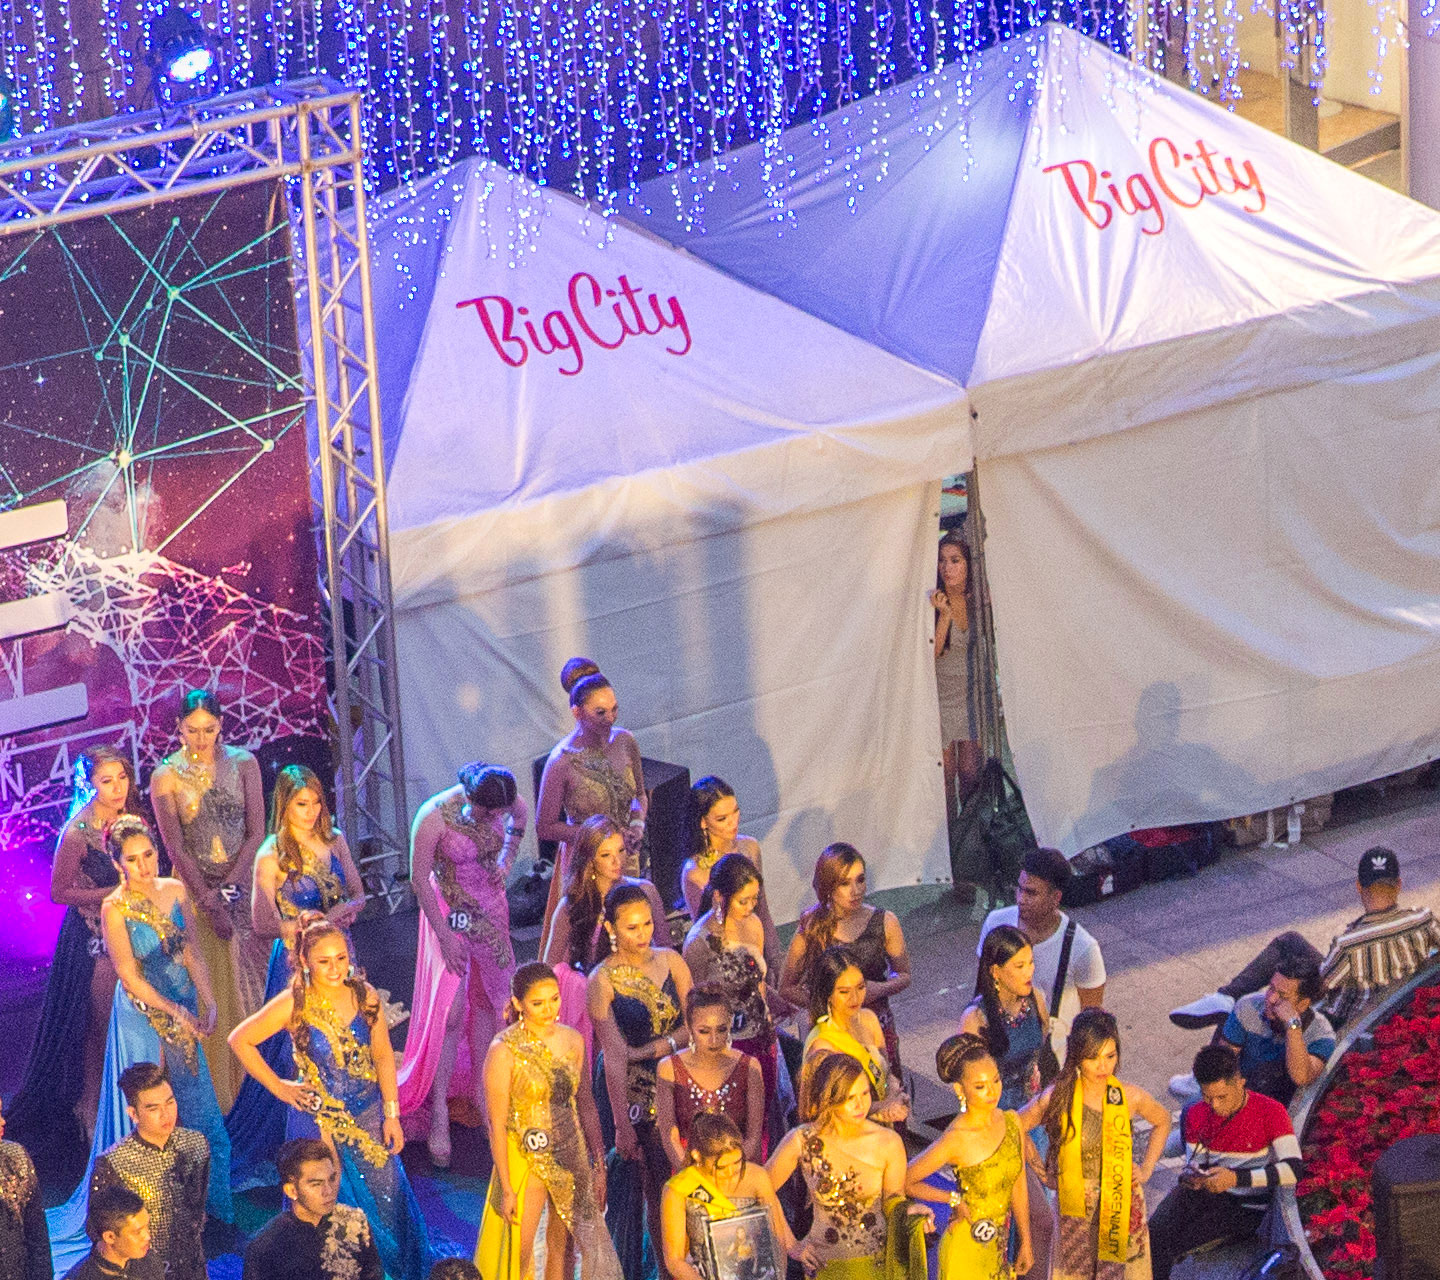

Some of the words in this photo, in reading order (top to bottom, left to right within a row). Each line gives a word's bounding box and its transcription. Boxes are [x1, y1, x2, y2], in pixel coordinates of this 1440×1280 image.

[1042, 137, 1266, 235] BigCity
[456, 271, 692, 376] BigCity
[50, 746, 76, 788] 4
[449, 912, 468, 929] 19
[527, 1133, 548, 1150] 09
[974, 1221, 995, 1241] 03
